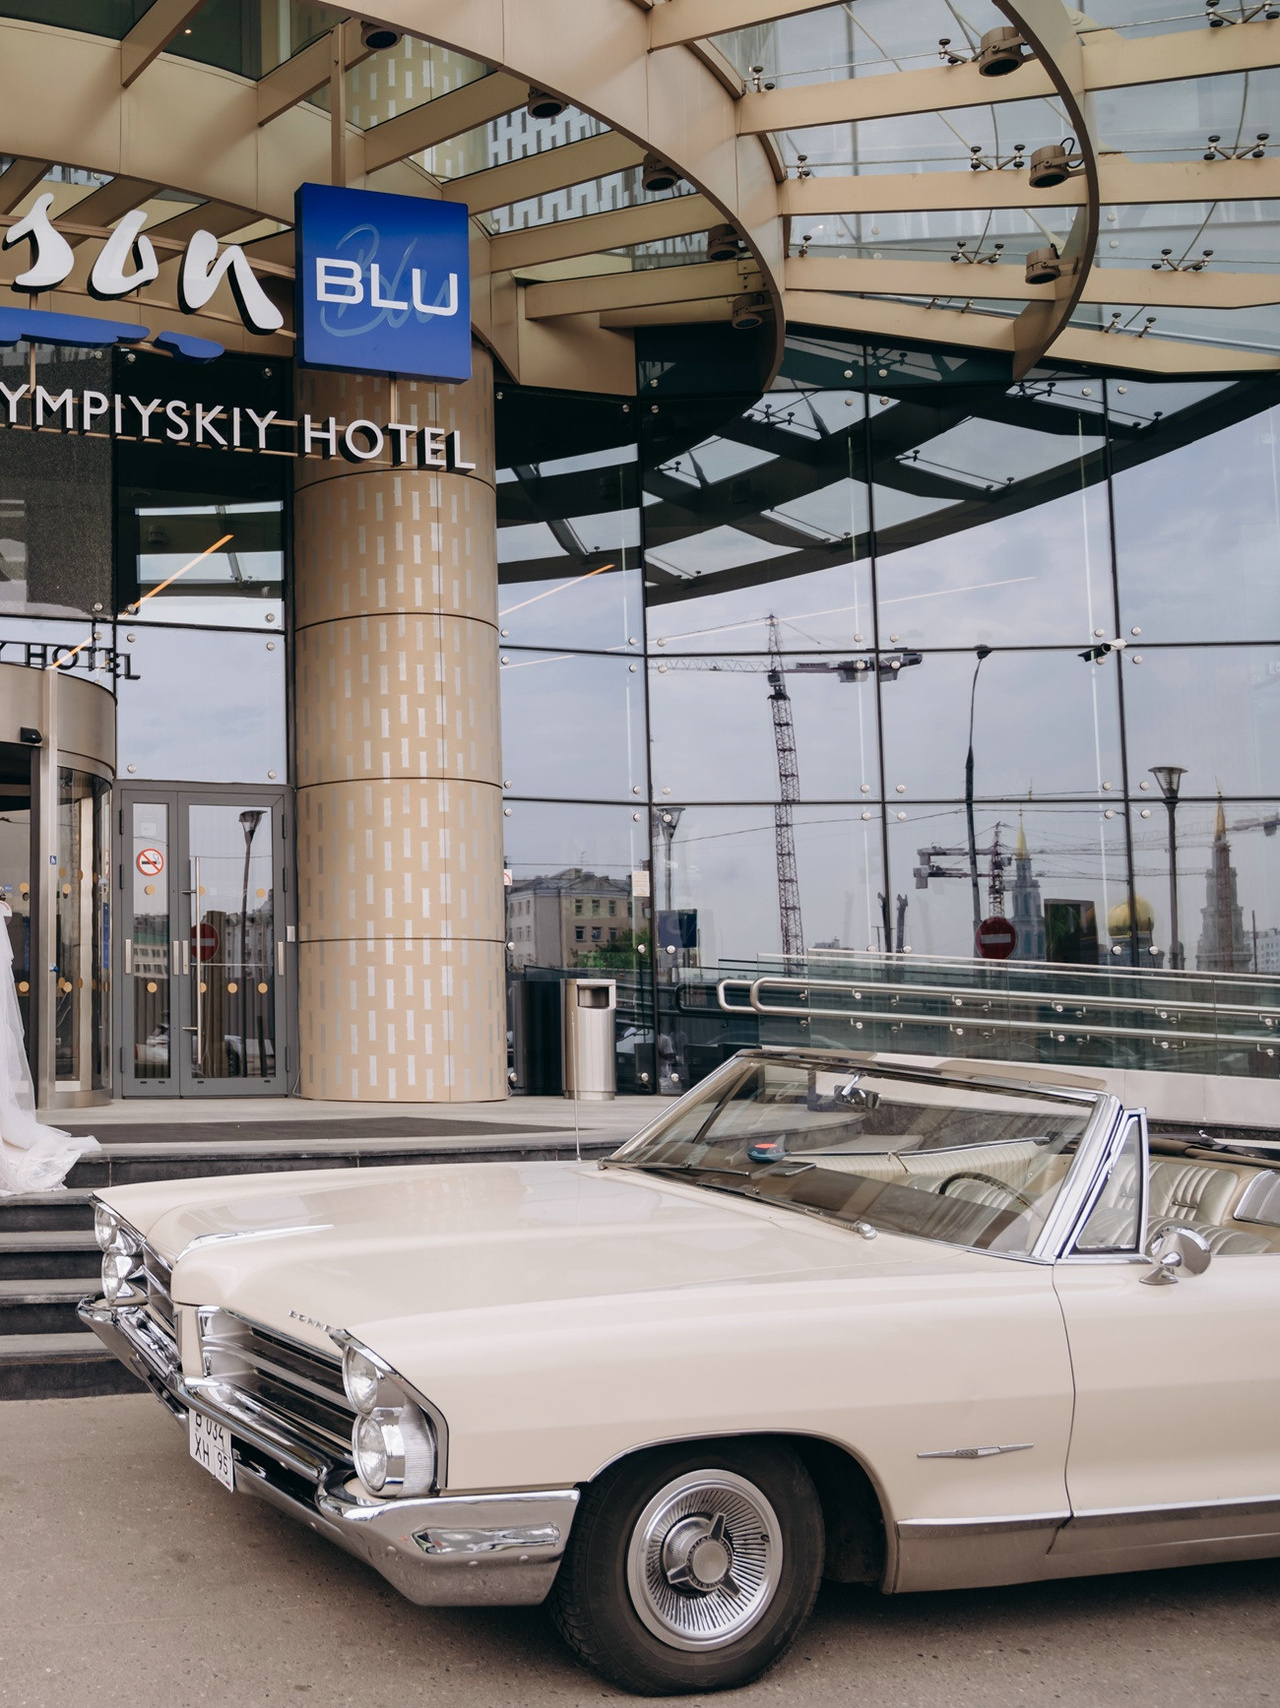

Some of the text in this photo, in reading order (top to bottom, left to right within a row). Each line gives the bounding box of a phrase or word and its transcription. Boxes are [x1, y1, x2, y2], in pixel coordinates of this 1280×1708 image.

[316, 257, 458, 316] BLU
[304, 414, 476, 472] HOTEL
[217, 1451, 228, 1475] 95
